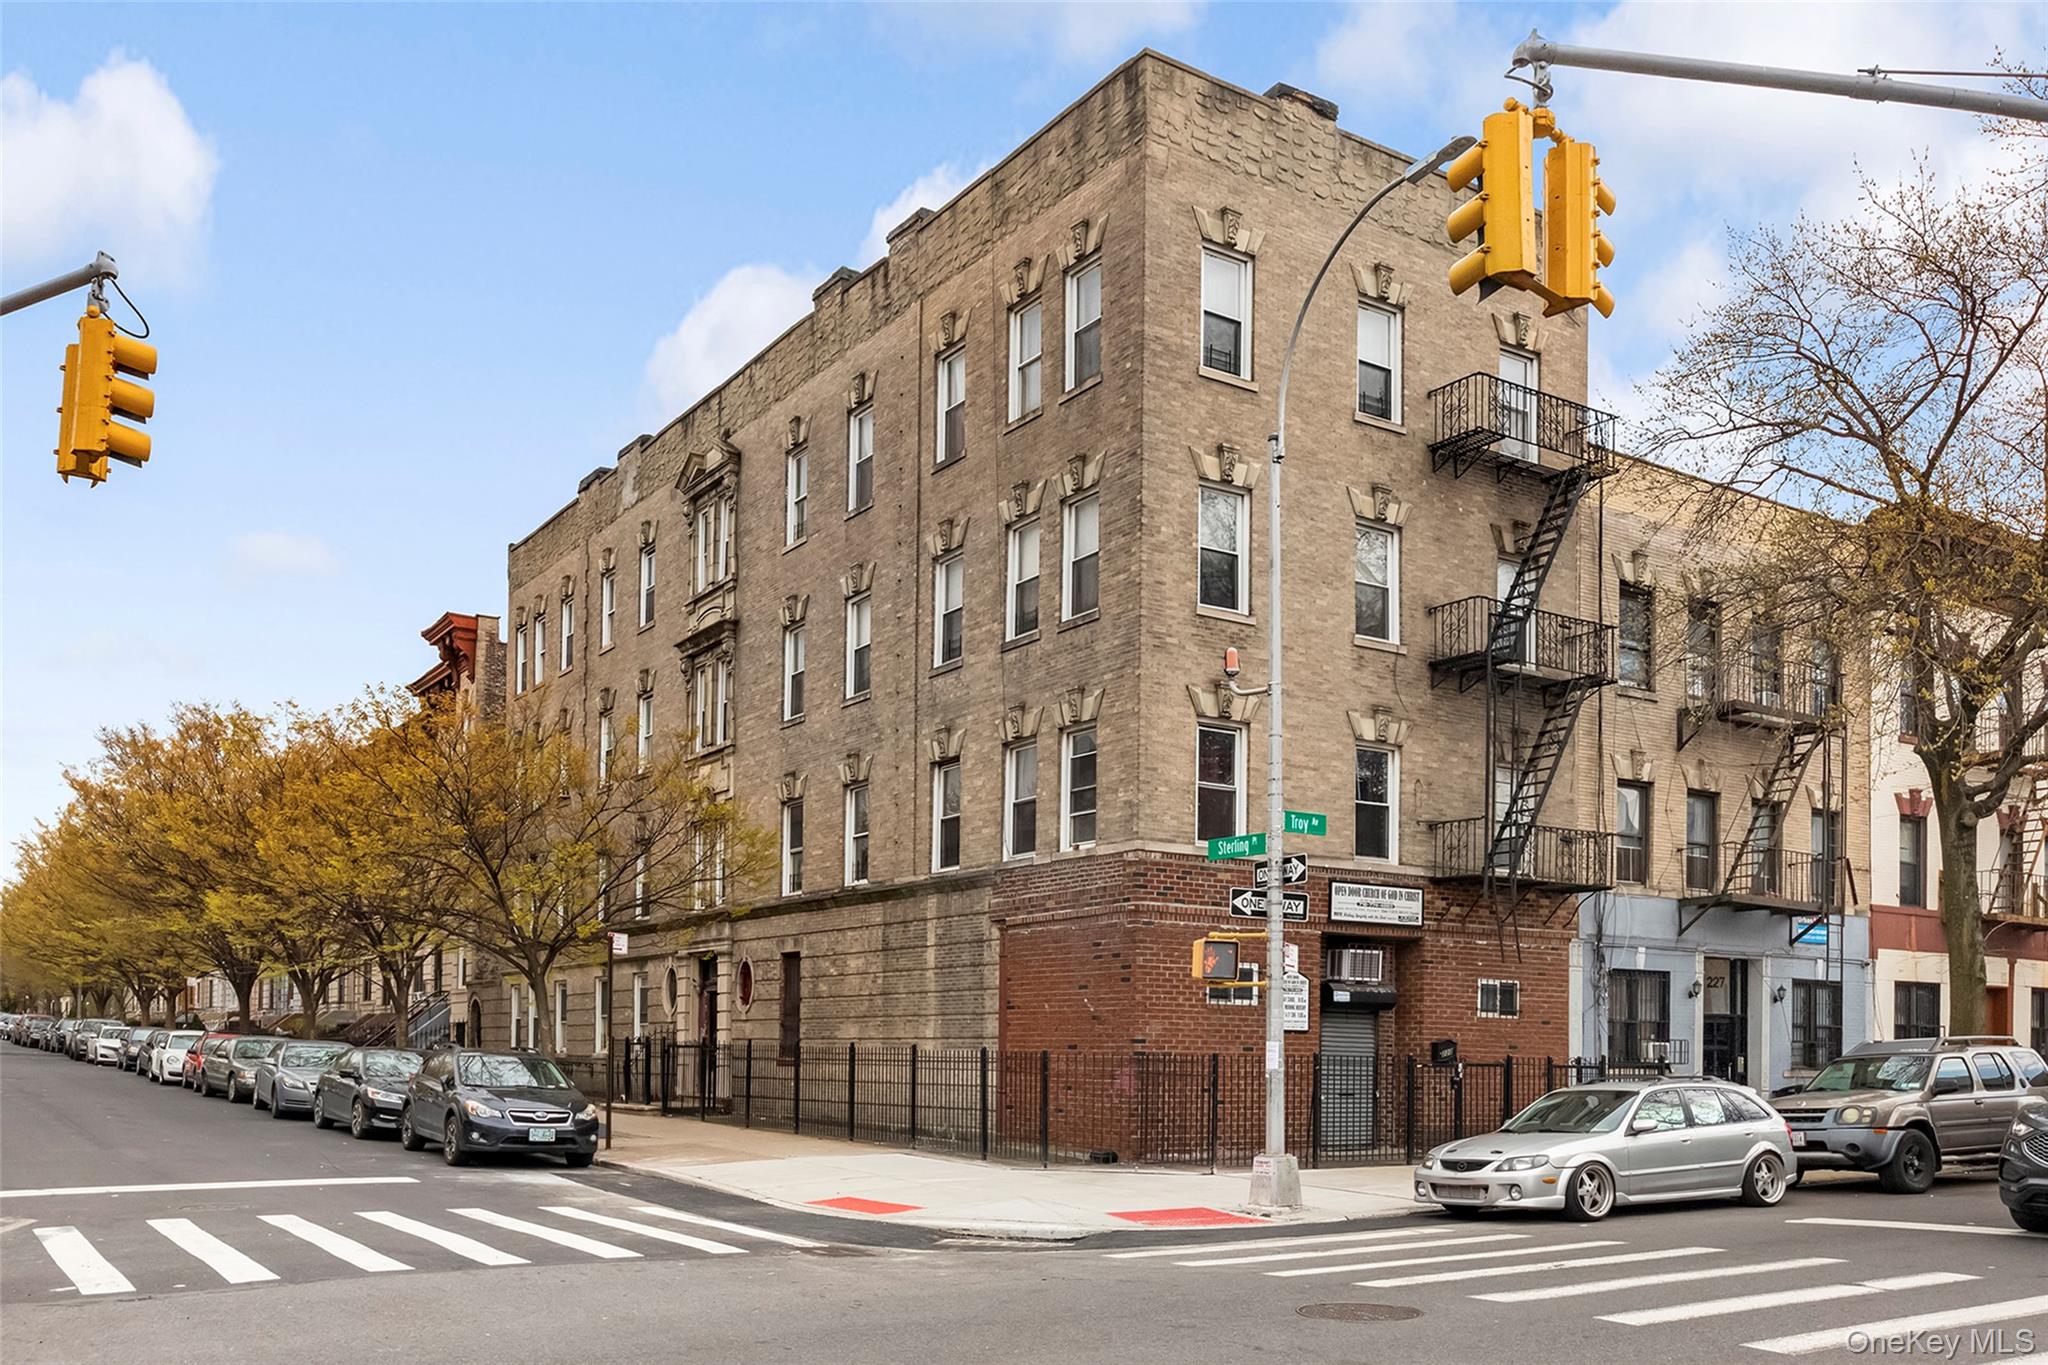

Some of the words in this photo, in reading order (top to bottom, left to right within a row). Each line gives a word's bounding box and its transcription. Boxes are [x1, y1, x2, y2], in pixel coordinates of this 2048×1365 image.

[1291, 814, 1309, 834] Troy
[1218, 840, 1249, 856] Sterling
[1252, 836, 1258, 845] Pl
[1258, 869, 1269, 881] ON
[1334, 885, 1347, 897] OPEN
[1347, 886, 1361, 898] DOOR
[1362, 887, 1380, 899] CHURCH
[1241, 897, 1264, 910] ONE
[1706, 976, 1725, 989] 227
